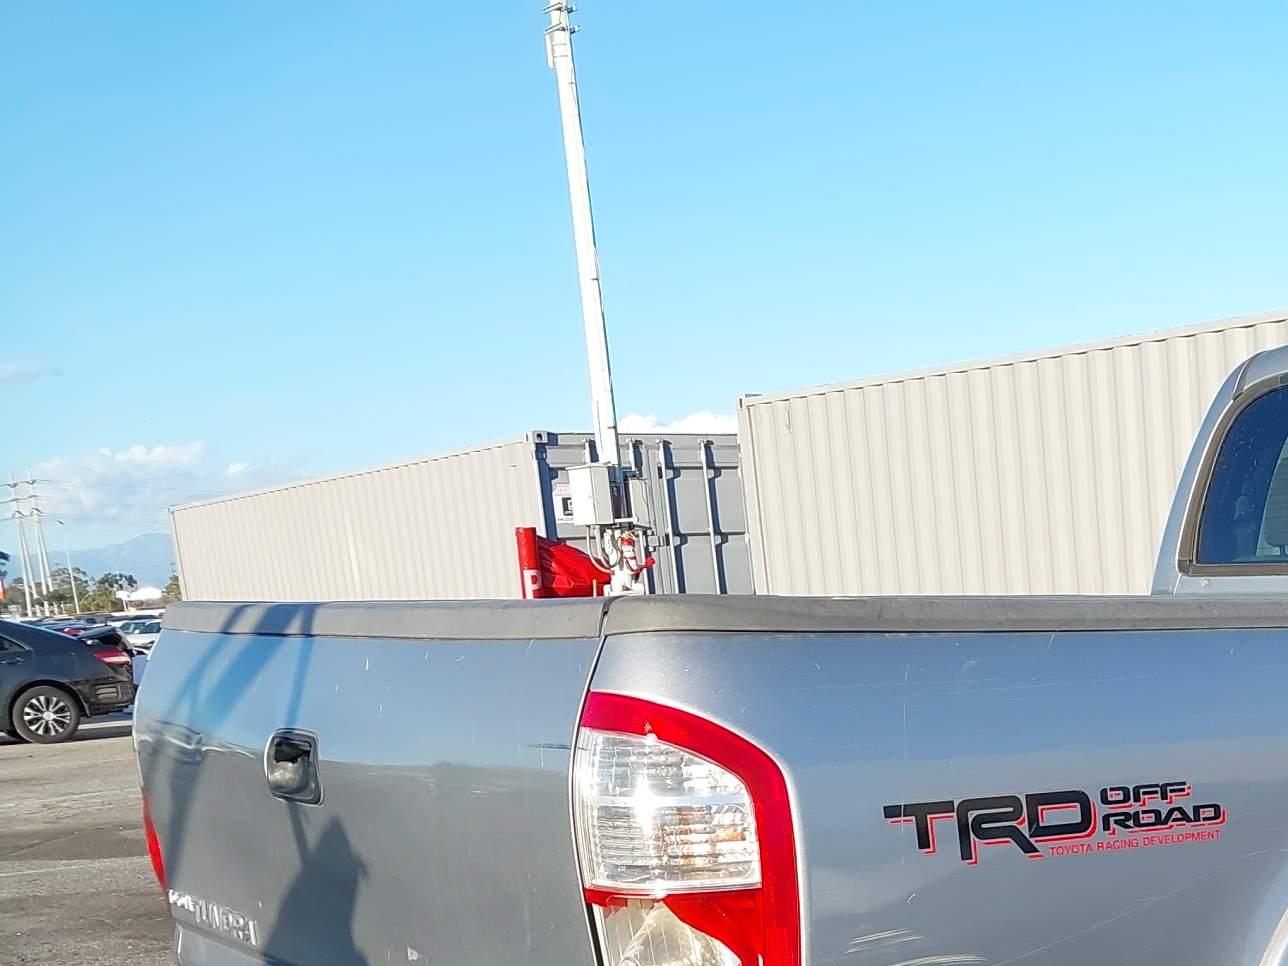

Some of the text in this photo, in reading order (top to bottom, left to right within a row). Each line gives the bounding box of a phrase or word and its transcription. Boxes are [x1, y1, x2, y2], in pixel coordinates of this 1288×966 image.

[1100, 781, 1192, 810] OFF
[883, 789, 1097, 865] TRD
[1101, 803, 1226, 835] ROAD
[1049, 829, 1222, 857] TOYOTA RACING DEVELOPMENT
